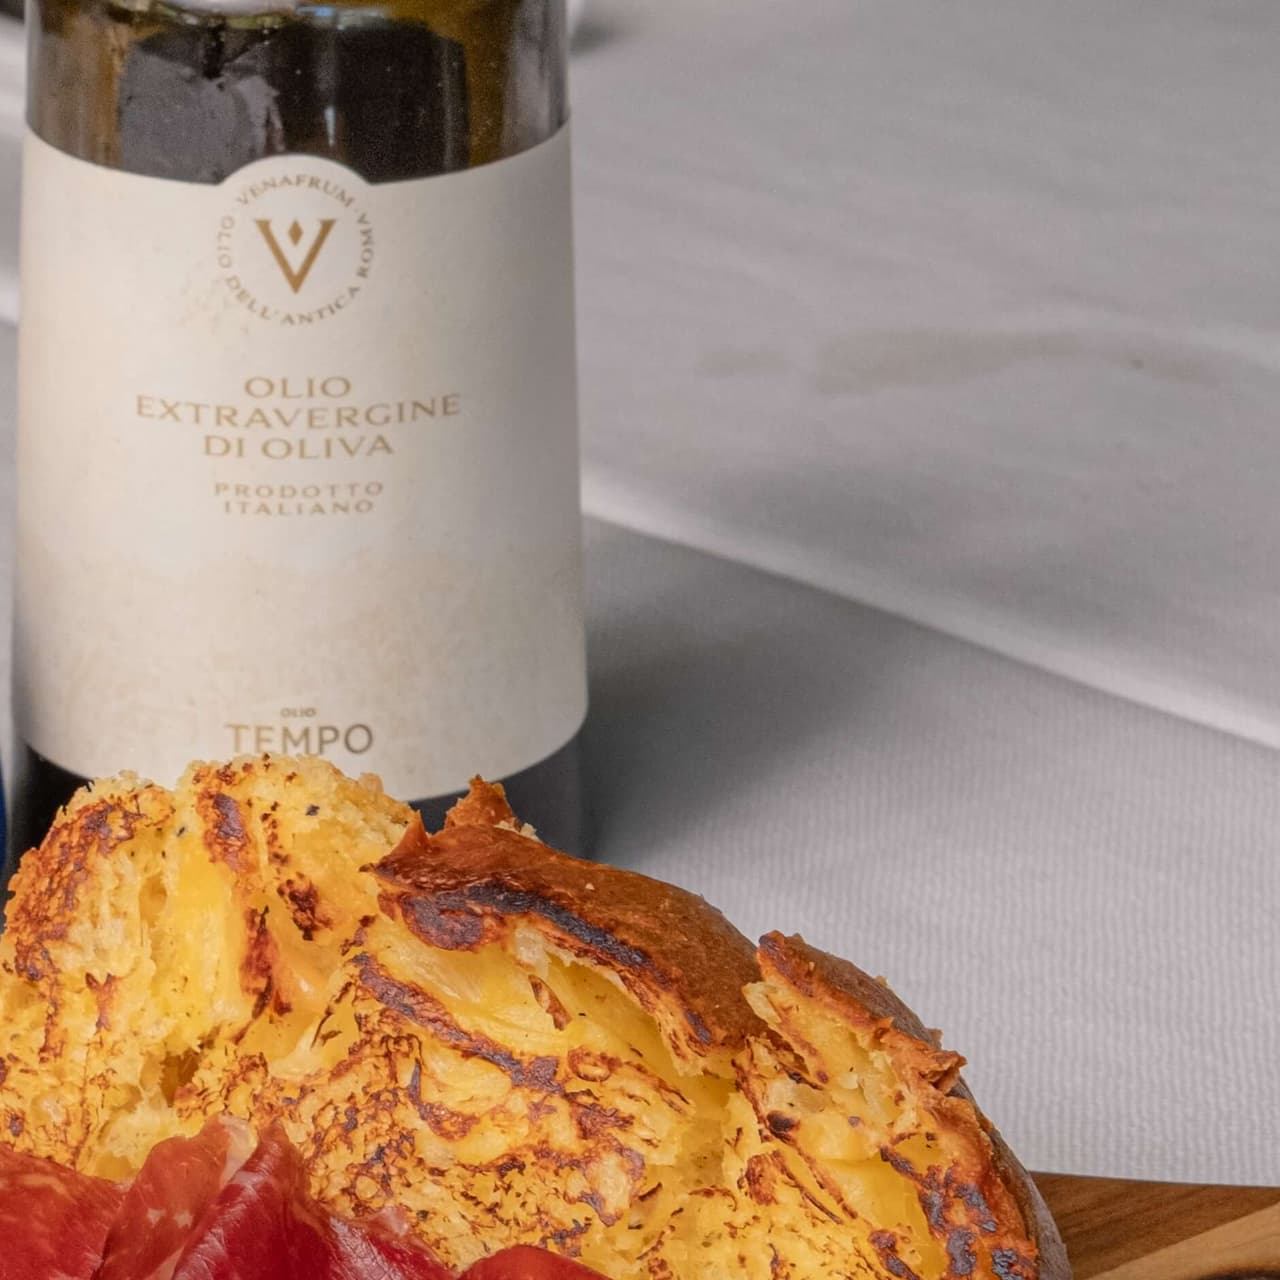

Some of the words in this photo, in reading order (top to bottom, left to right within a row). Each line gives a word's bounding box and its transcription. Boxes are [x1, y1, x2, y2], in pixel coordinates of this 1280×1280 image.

[236, 174, 355, 208] VENAFRUM
[217, 215, 236, 270] OLIO
[255, 218, 337, 295] V
[356, 211, 376, 279] ROMA
[225, 275, 361, 326] DELL'ANTICA
[244, 376, 352, 399] OLIO
[135, 393, 462, 430] EXTRAVERGINE
[203, 434, 245, 459] DI
[261, 433, 394, 460] OLIVA
[213, 481, 384, 499] PRODOTTO
[225, 499, 375, 516] ITALIANO
[226, 722, 374, 756] TEMPO
